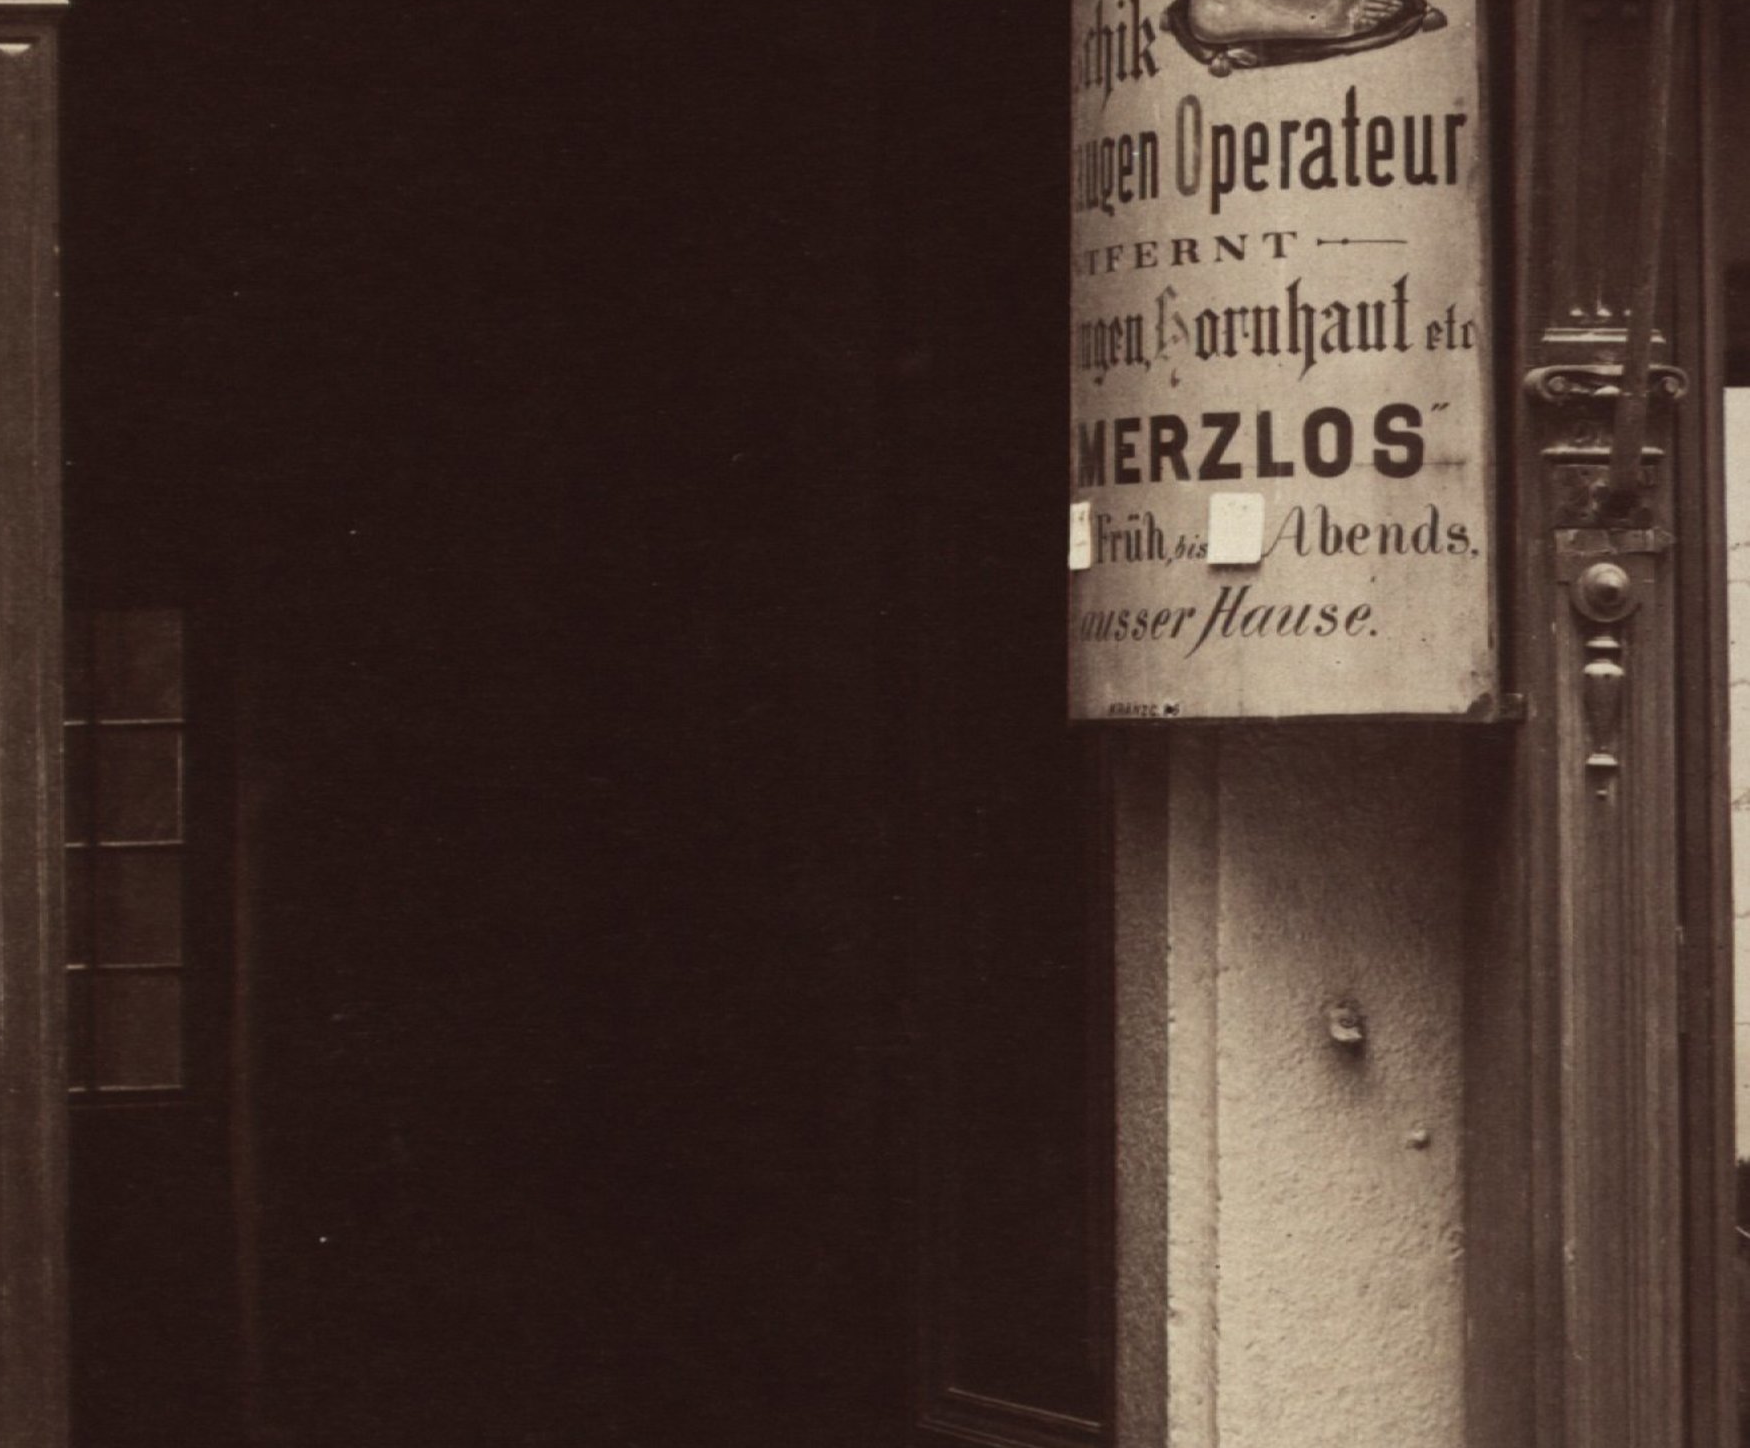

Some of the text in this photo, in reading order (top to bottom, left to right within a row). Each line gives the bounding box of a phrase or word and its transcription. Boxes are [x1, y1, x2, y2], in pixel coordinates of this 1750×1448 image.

[1174, 83, 1468, 217] Operateur
[1073, 230, 1300, 278] TFERNT
[1184, 582, 1380, 661] Hause.
